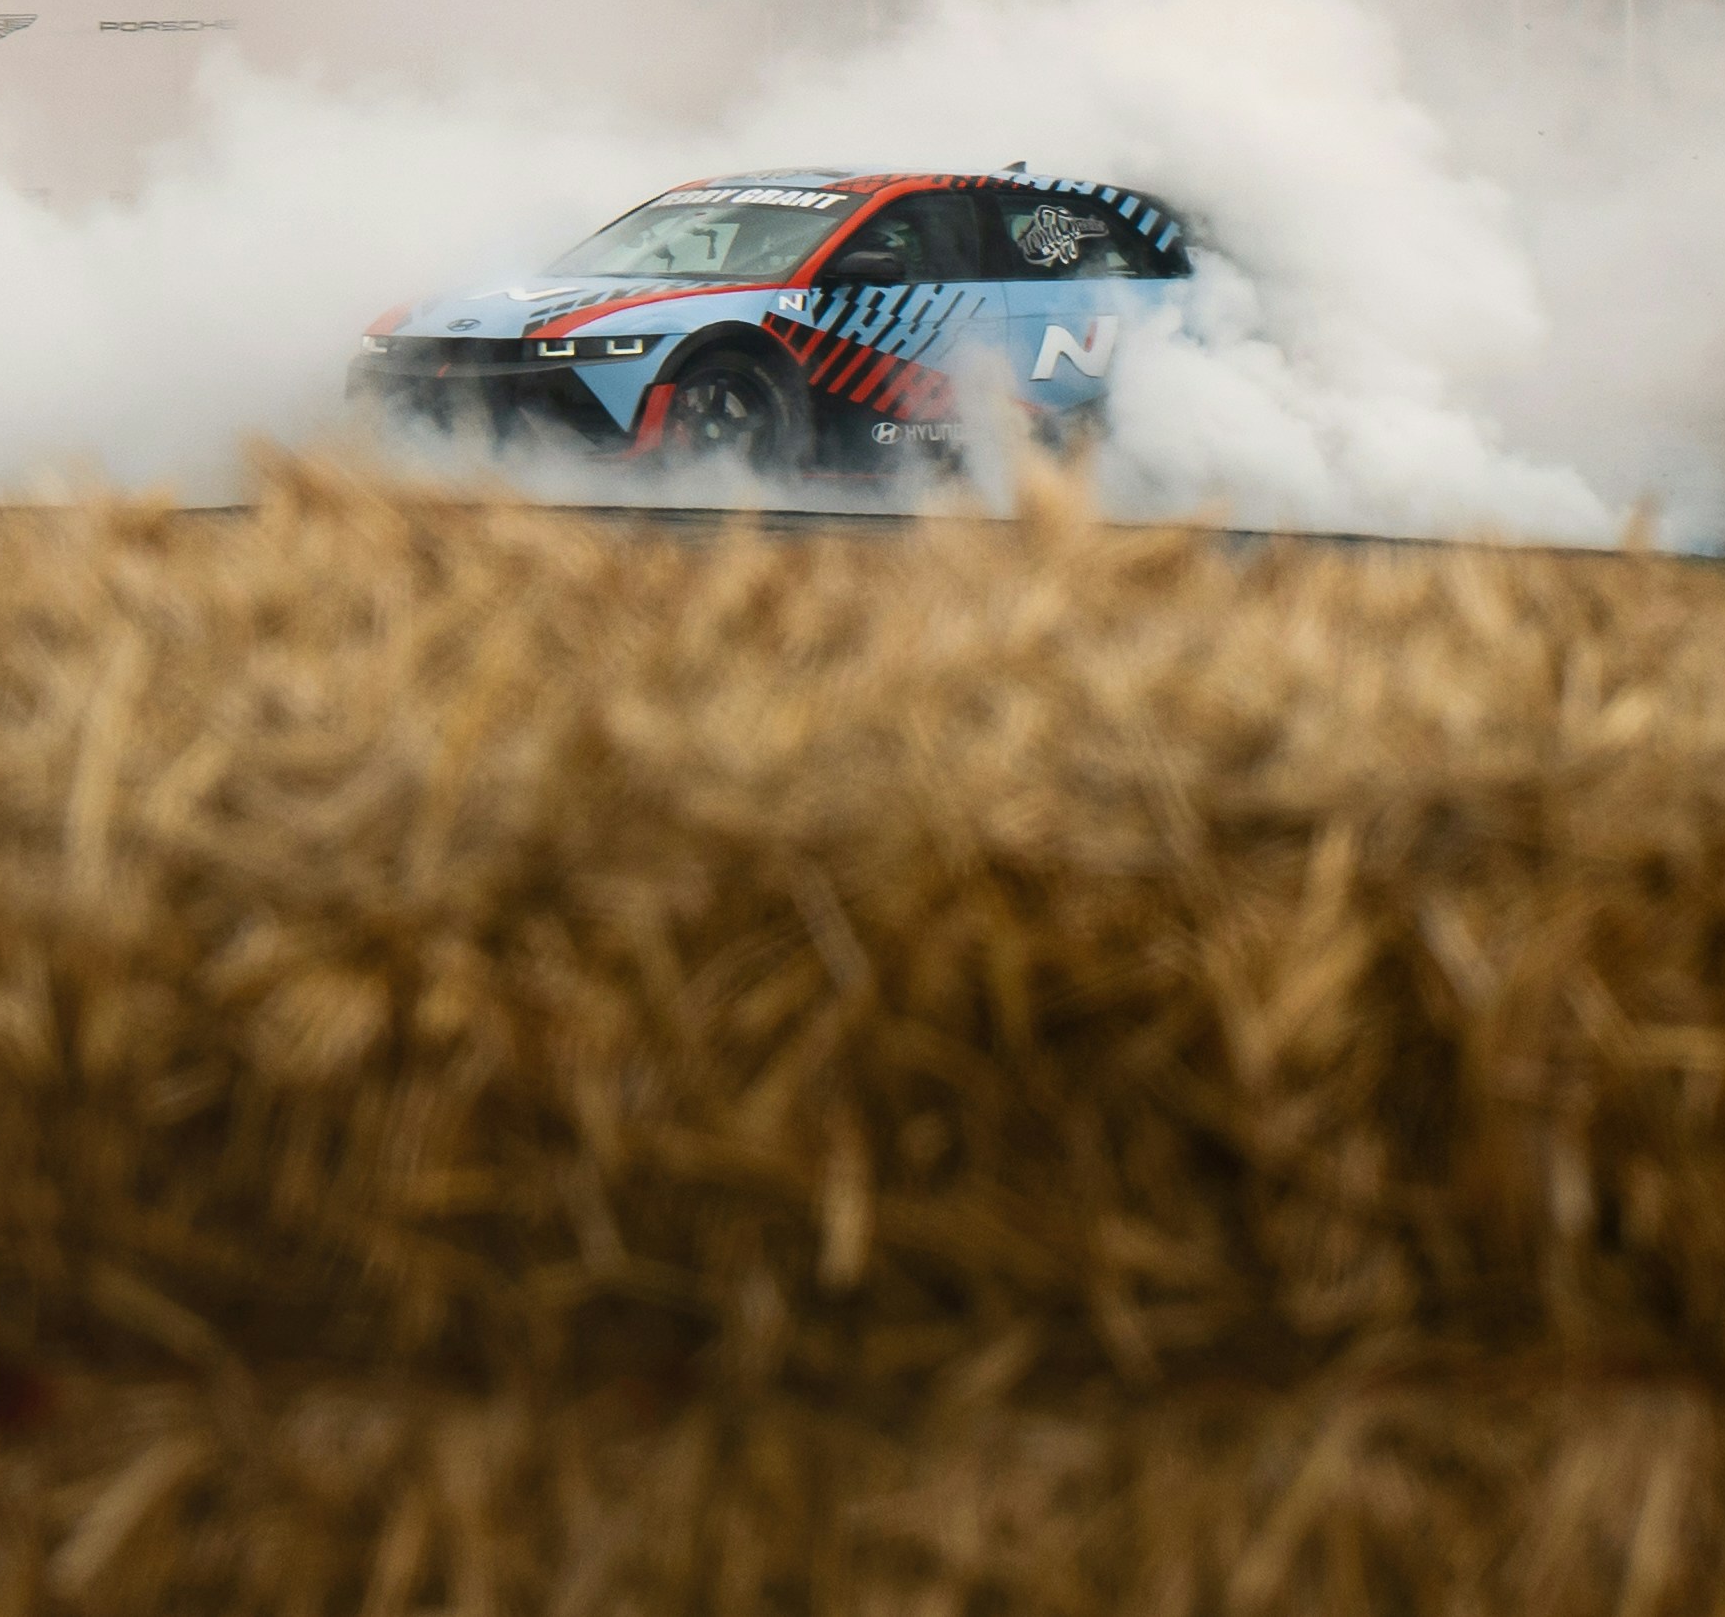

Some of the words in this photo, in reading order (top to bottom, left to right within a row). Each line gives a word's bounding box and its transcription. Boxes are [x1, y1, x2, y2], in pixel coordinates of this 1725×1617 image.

[100, 20, 242, 33] PORSCHE
[730, 188, 849, 210] GRANT
[1029, 315, 1119, 382] N
